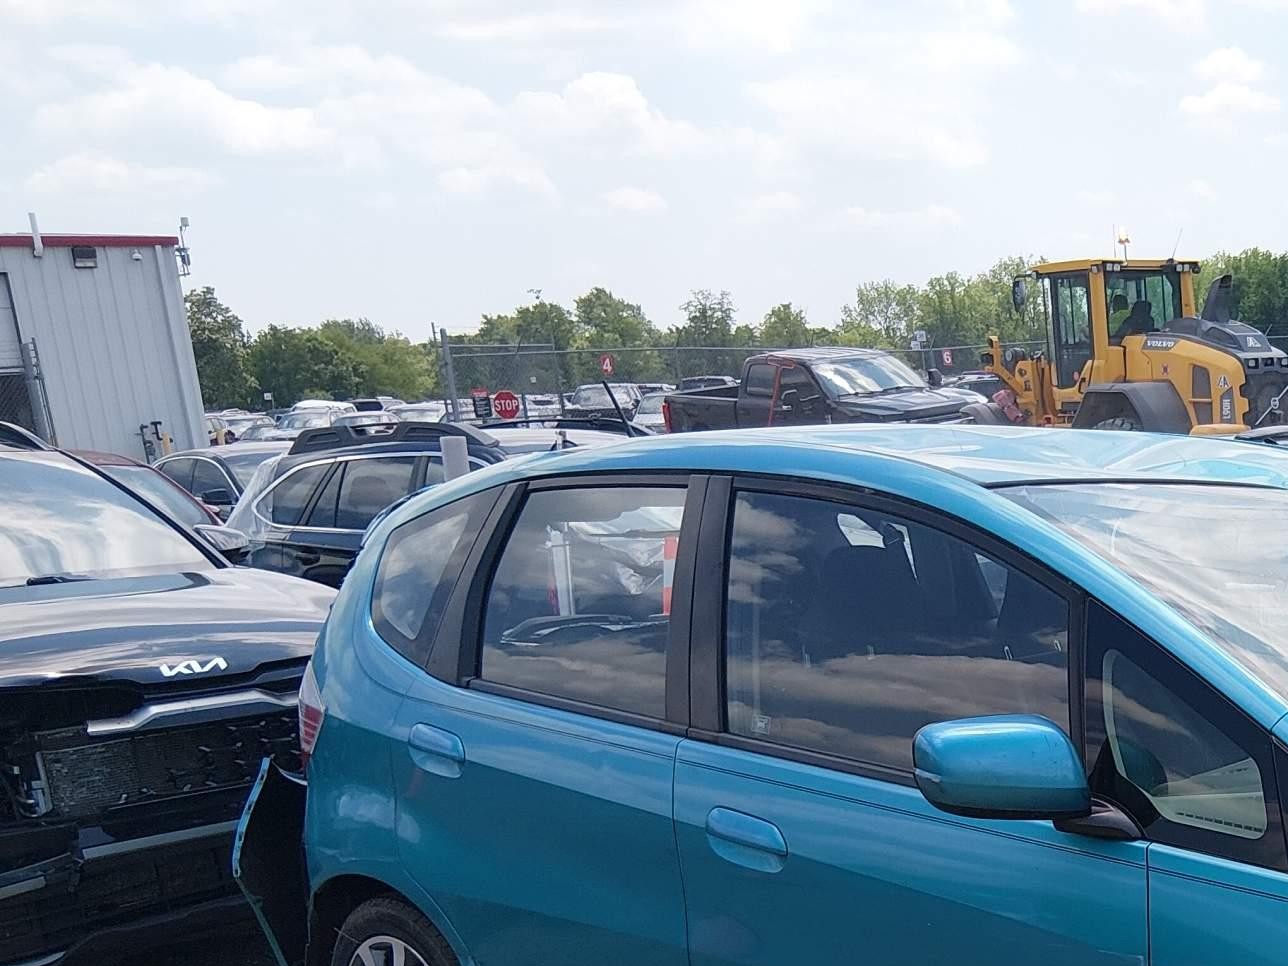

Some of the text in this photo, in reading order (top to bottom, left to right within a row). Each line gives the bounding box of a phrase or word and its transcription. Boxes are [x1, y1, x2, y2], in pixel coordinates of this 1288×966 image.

[1146, 340, 1175, 348] VOLVO
[943, 351, 953, 364] 6
[602, 358, 612, 372] 4
[494, 399, 518, 412] STOP
[160, 657, 228, 677] KIA
